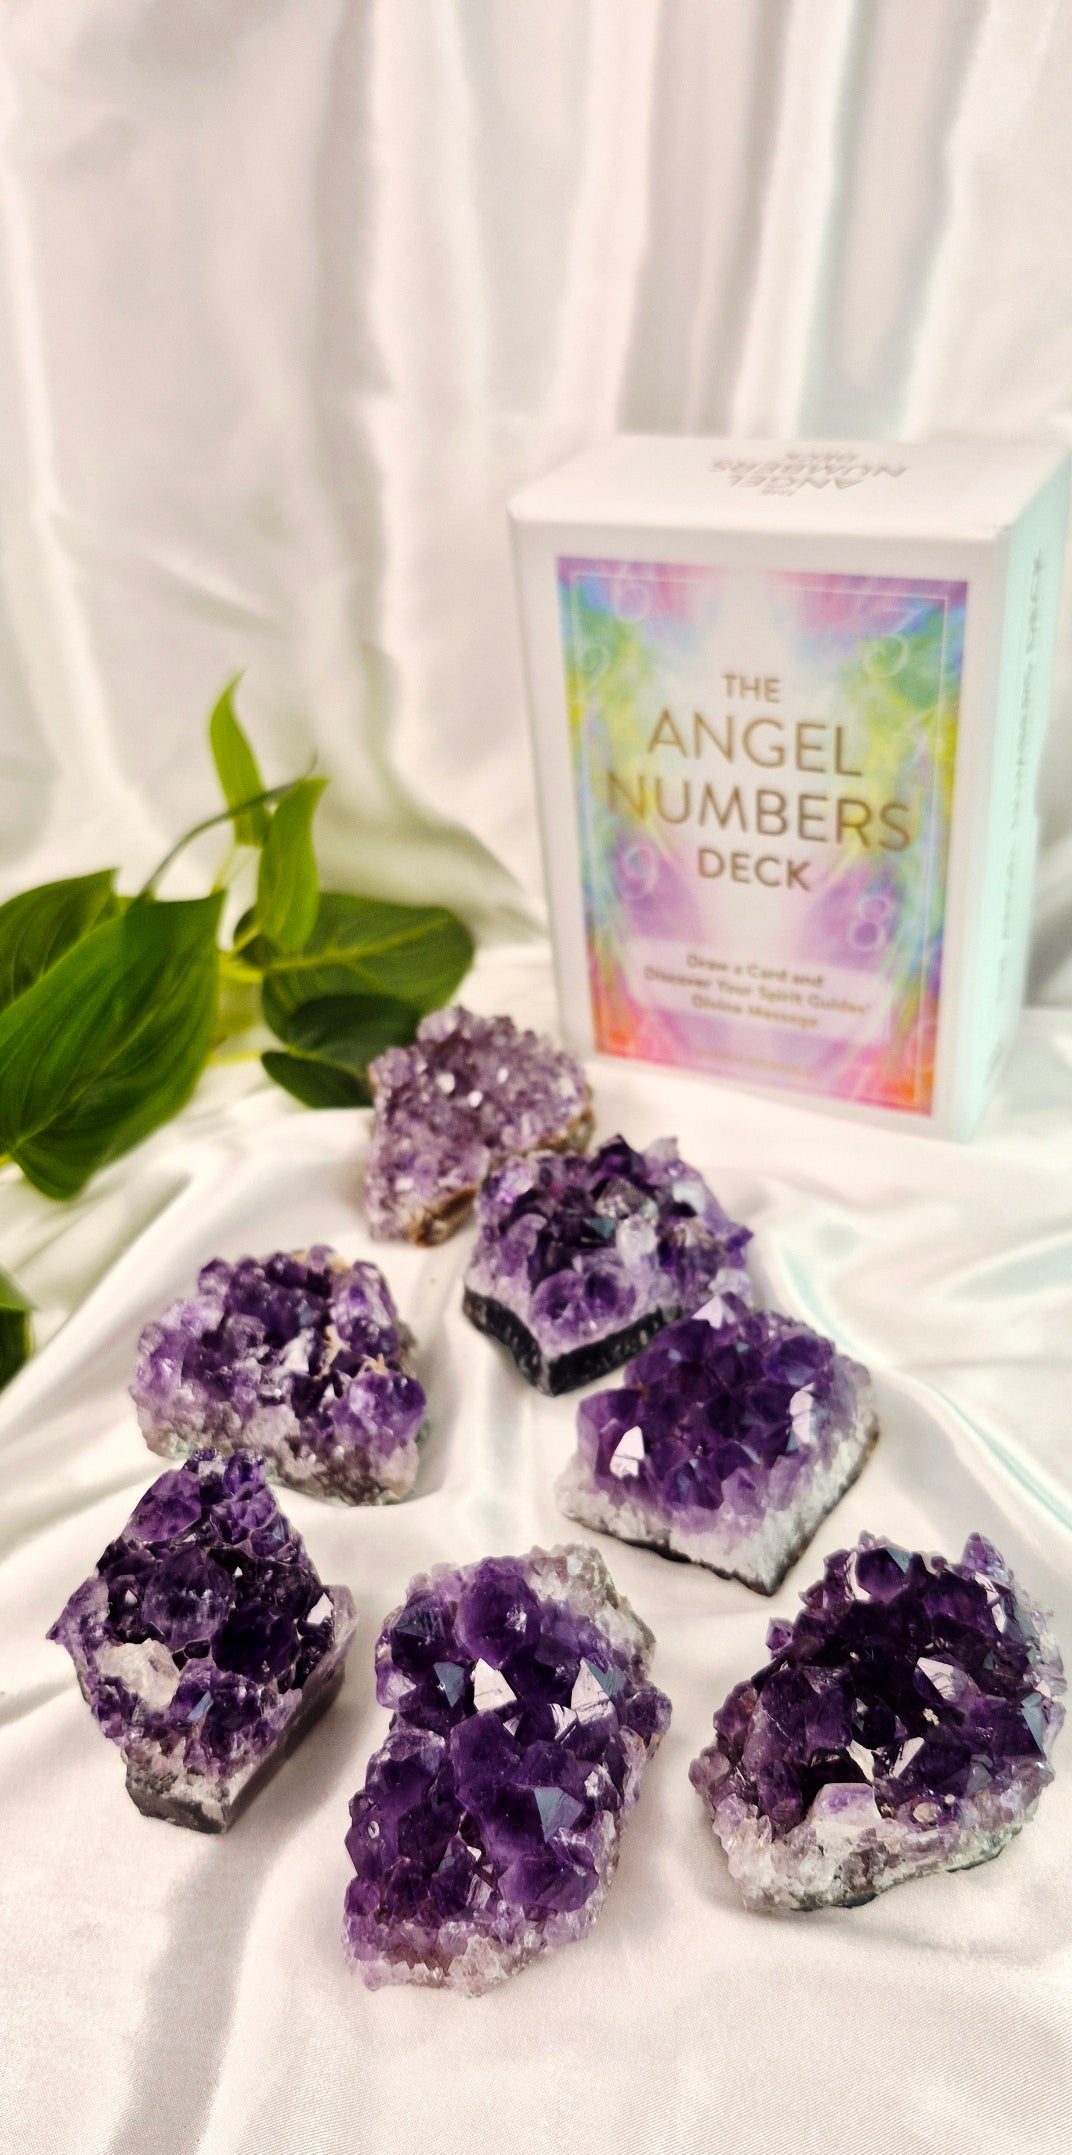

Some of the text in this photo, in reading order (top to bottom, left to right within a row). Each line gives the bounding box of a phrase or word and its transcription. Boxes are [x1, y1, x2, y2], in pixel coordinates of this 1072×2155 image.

[723, 672, 781, 703] THE
[648, 708, 862, 777] ANGEL
[607, 771, 910, 852] NUMBERS
[698, 847, 811, 892] DECK
[644, 966, 711, 989] Discover
[717, 980, 752, 998] Your
[758, 985, 802, 1006] Spirit
[686, 954, 729, 972] Draw
[749, 964, 787, 983] Card
[791, 972, 823, 989] and
